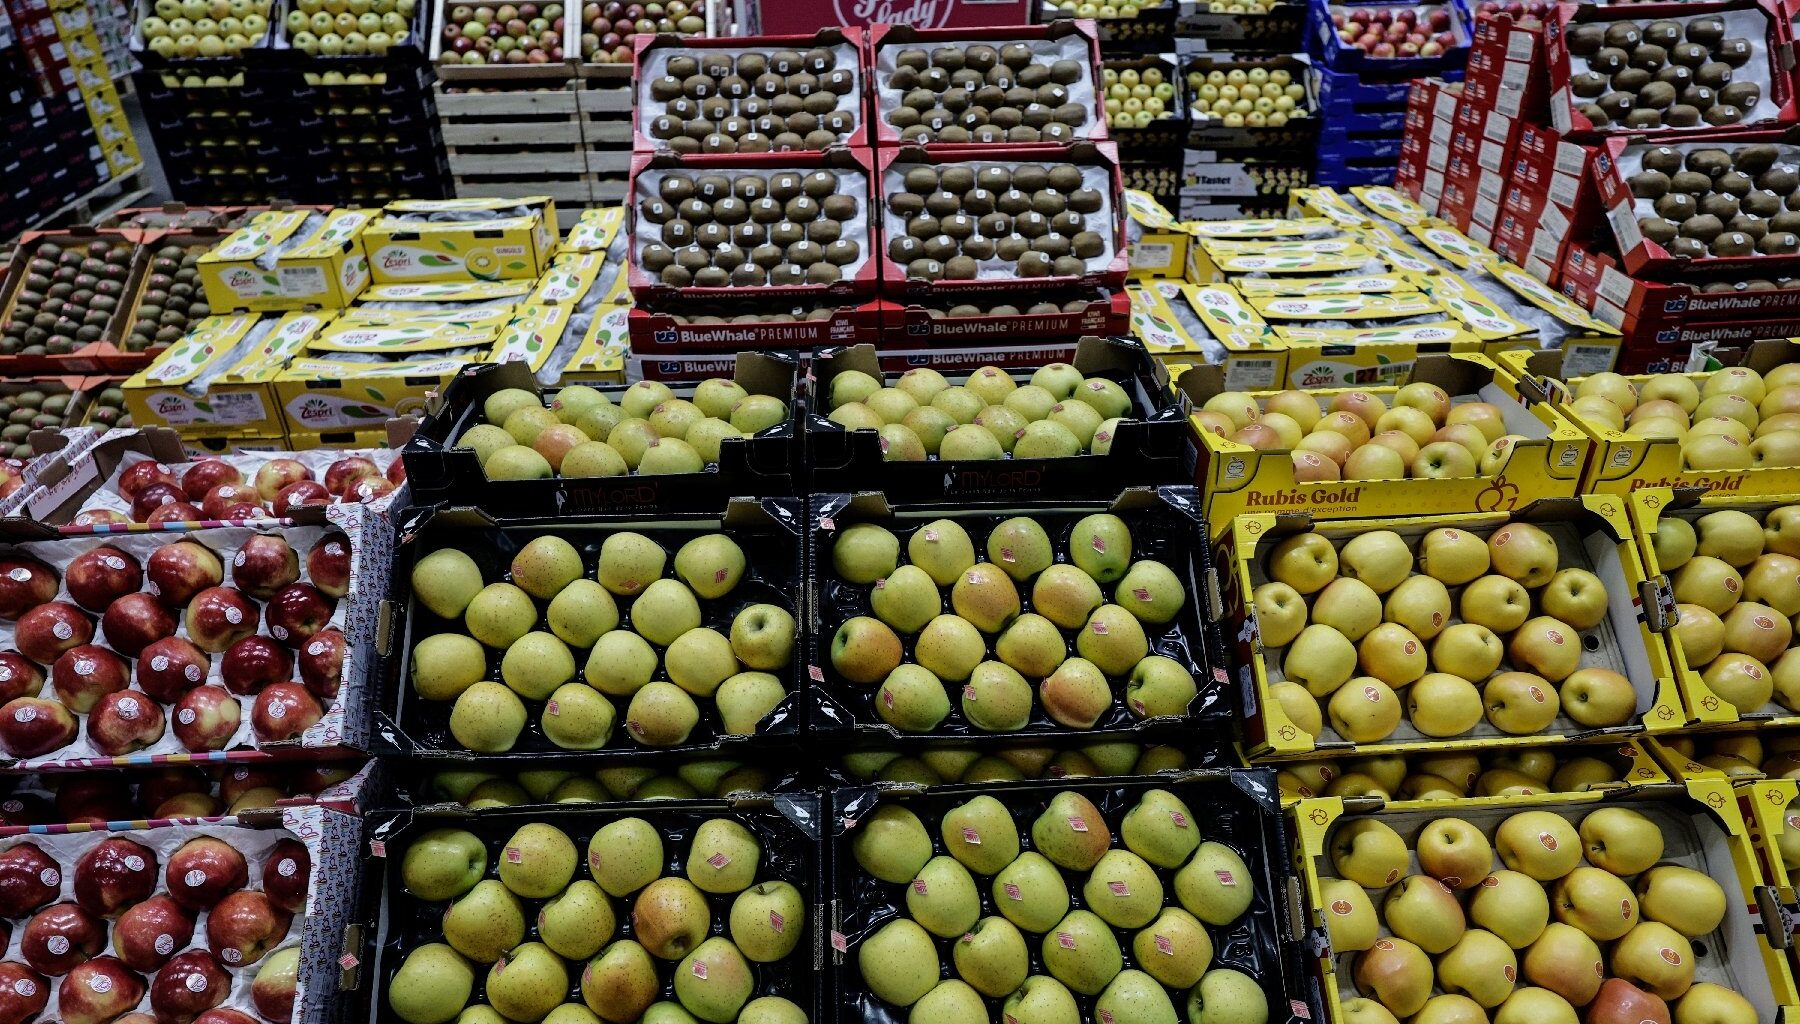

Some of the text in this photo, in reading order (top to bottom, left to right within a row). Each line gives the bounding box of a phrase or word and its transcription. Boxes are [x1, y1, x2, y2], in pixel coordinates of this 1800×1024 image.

[1688, 297, 1760, 310] BlueWhale
[933, 318, 1069, 335] BlueWhale PREMIUM
[681, 327, 818, 343] BlueWhale PREMIUM
[1681, 329, 1752, 341] BlueWhale
[932, 352, 1006, 364] BlueWhale
[685, 361, 735, 373] BlueWh
[1302, 373, 1335, 386] Zespri
[299, 406, 333, 419] Zespri
[1694, 475, 1745, 491] Gold
[1246, 487, 1361, 506] Rubis Gold
